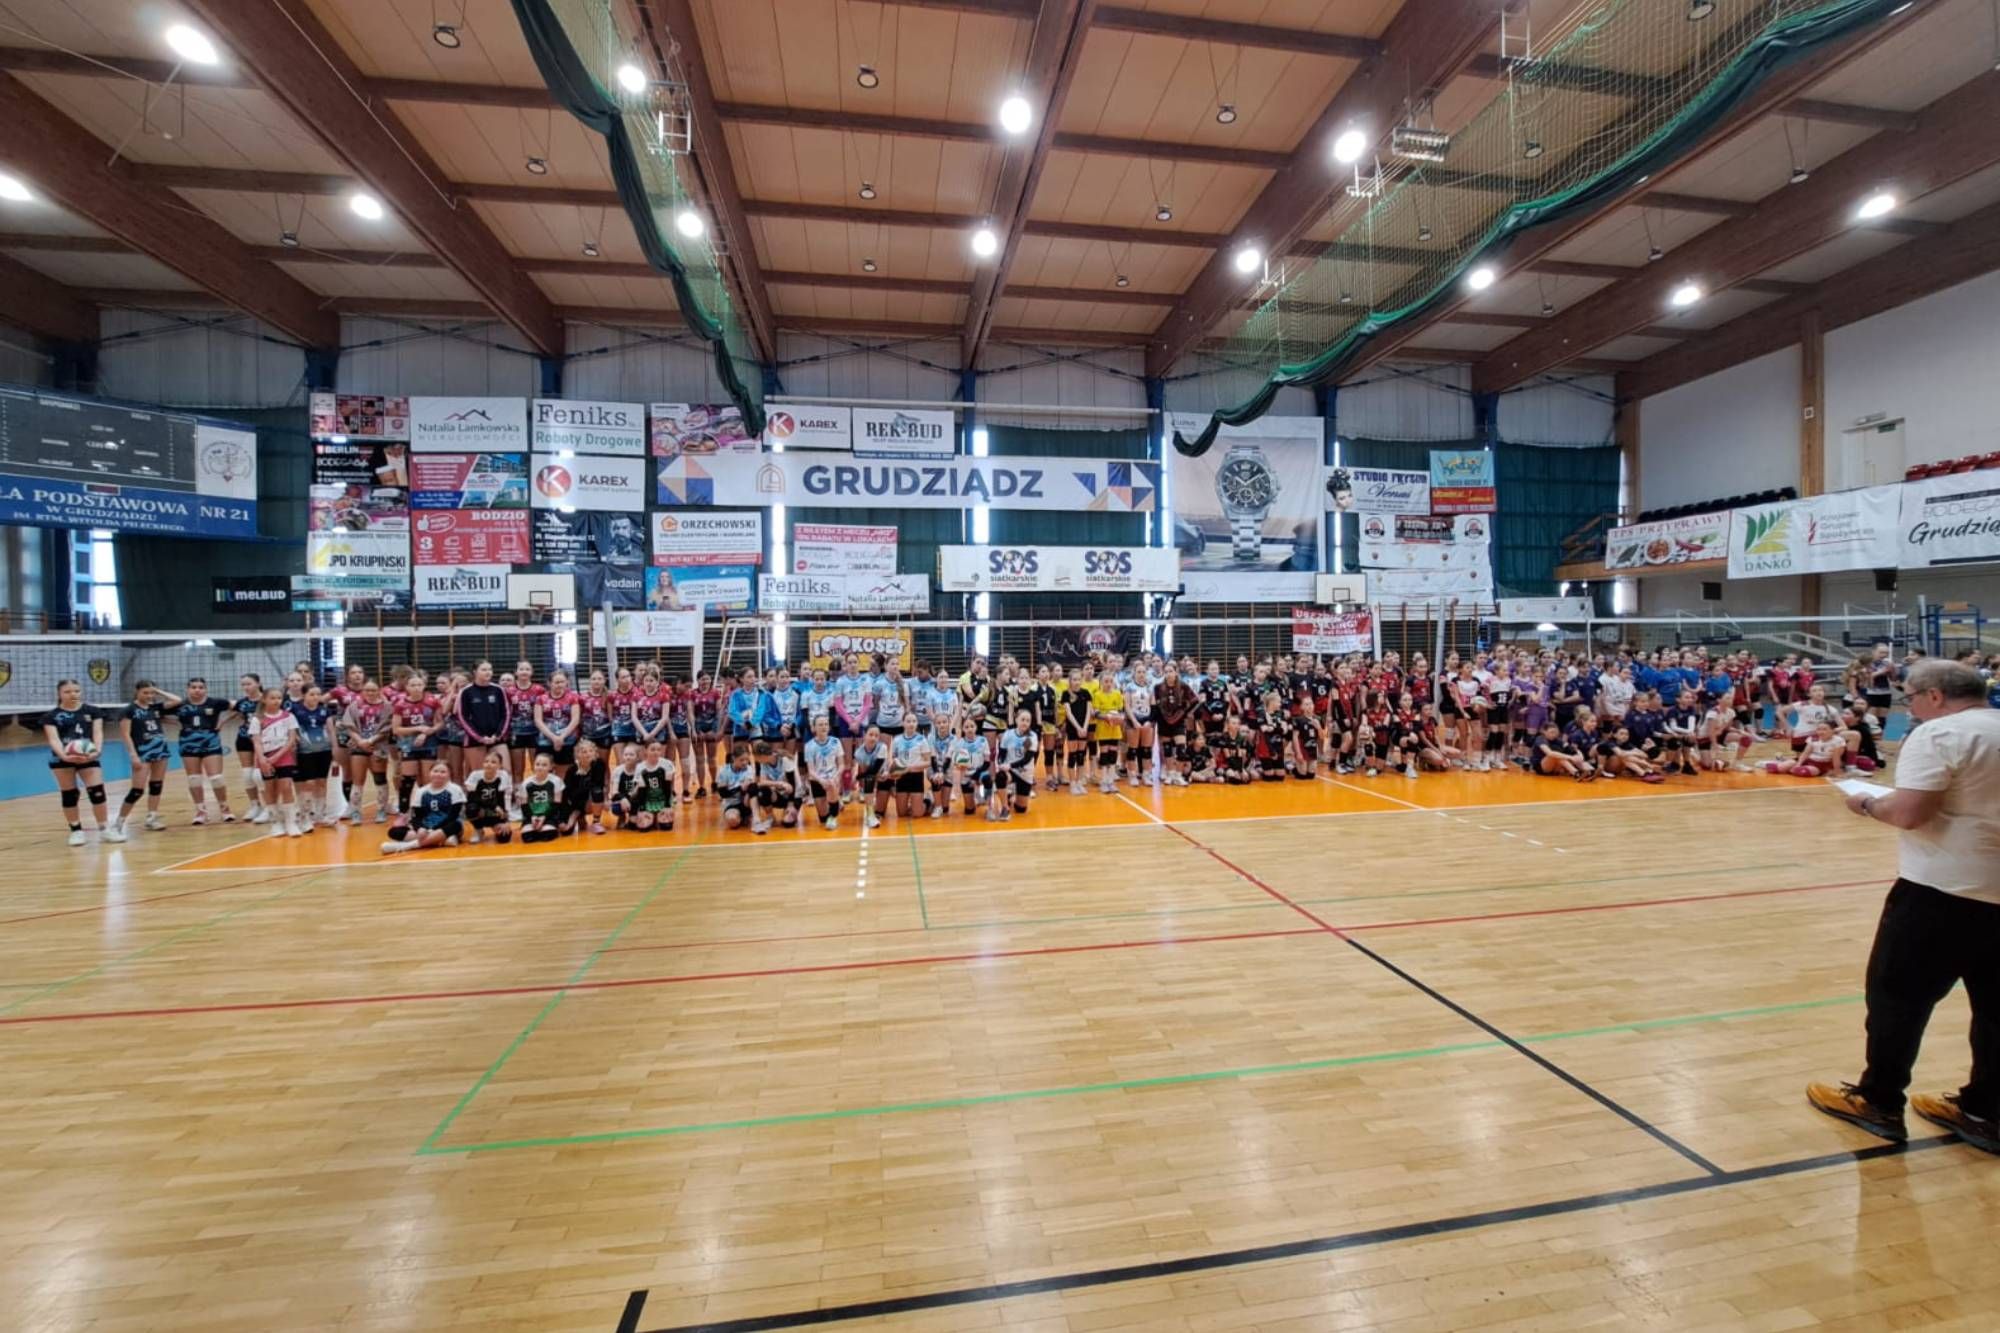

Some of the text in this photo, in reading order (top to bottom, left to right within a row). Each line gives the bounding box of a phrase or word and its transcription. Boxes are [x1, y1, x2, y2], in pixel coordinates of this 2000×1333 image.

[536, 404, 628, 427] Feniks
[418, 423, 520, 433] Natalia Lamkowska
[800, 419, 838, 430] KAREX
[535, 431, 641, 449] Roboty Drogowe
[578, 474, 629, 487] KAREX
[1353, 471, 1388, 482] STUDIO
[802, 465, 1044, 503] GRUDZIĄDZ
[33, 488, 189, 516] PODSTAWOWA
[200, 506, 226, 520] NR
[230, 509, 250, 521] 21
[46, 505, 61, 514] W
[681, 519, 756, 529] ORZECHOWSKI
[1640, 514, 1725, 534] PRZYPRAWY
[1744, 559, 1792, 572] DANKO
[765, 577, 831, 594] Feniks
[1318, 685, 1326, 696] 6
[1043, 693, 1049, 706] 1
[75, 723, 83, 734] 4
[532, 790, 548, 802] 29
[430, 799, 439, 811] 8
